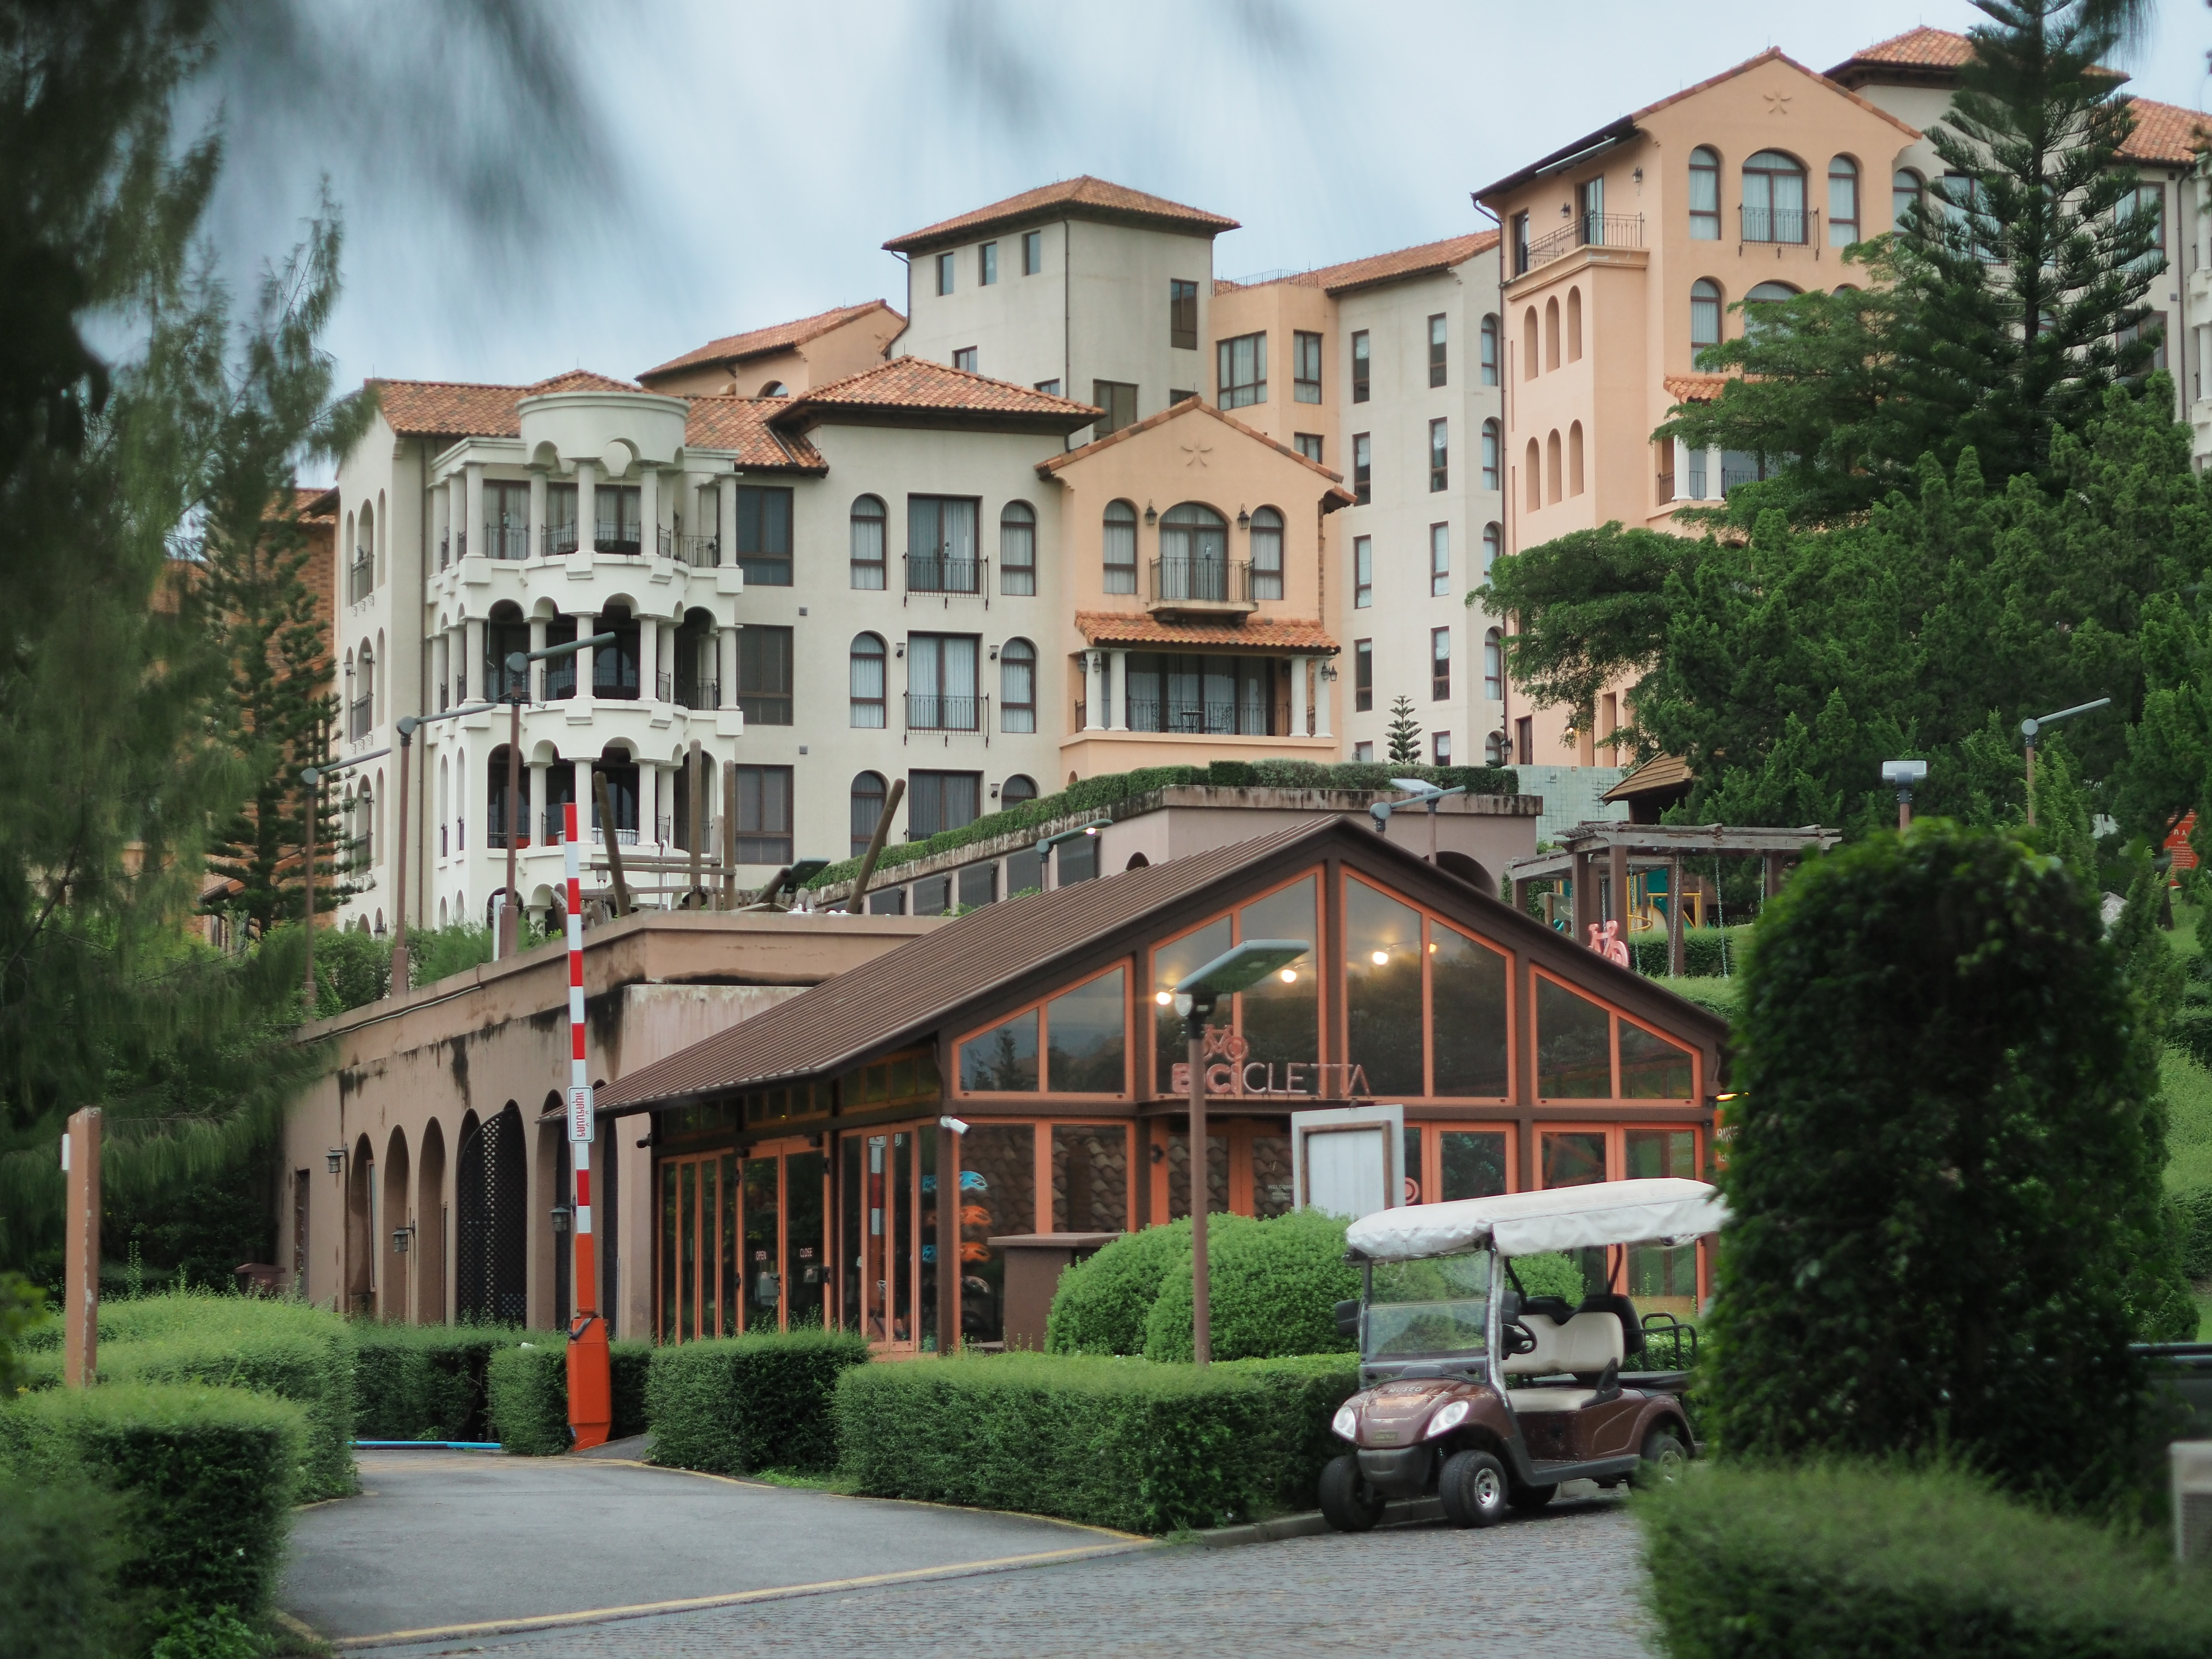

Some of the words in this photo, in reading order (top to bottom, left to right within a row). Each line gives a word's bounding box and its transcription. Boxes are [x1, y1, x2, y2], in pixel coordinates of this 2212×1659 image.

[1172, 1062, 1371, 1098] BCICLETTA
[572, 1092, 589, 1137] หยุดรับบัตร
[756, 1250, 767, 1260] OPEN
[800, 1248, 813, 1258] CLOSE
